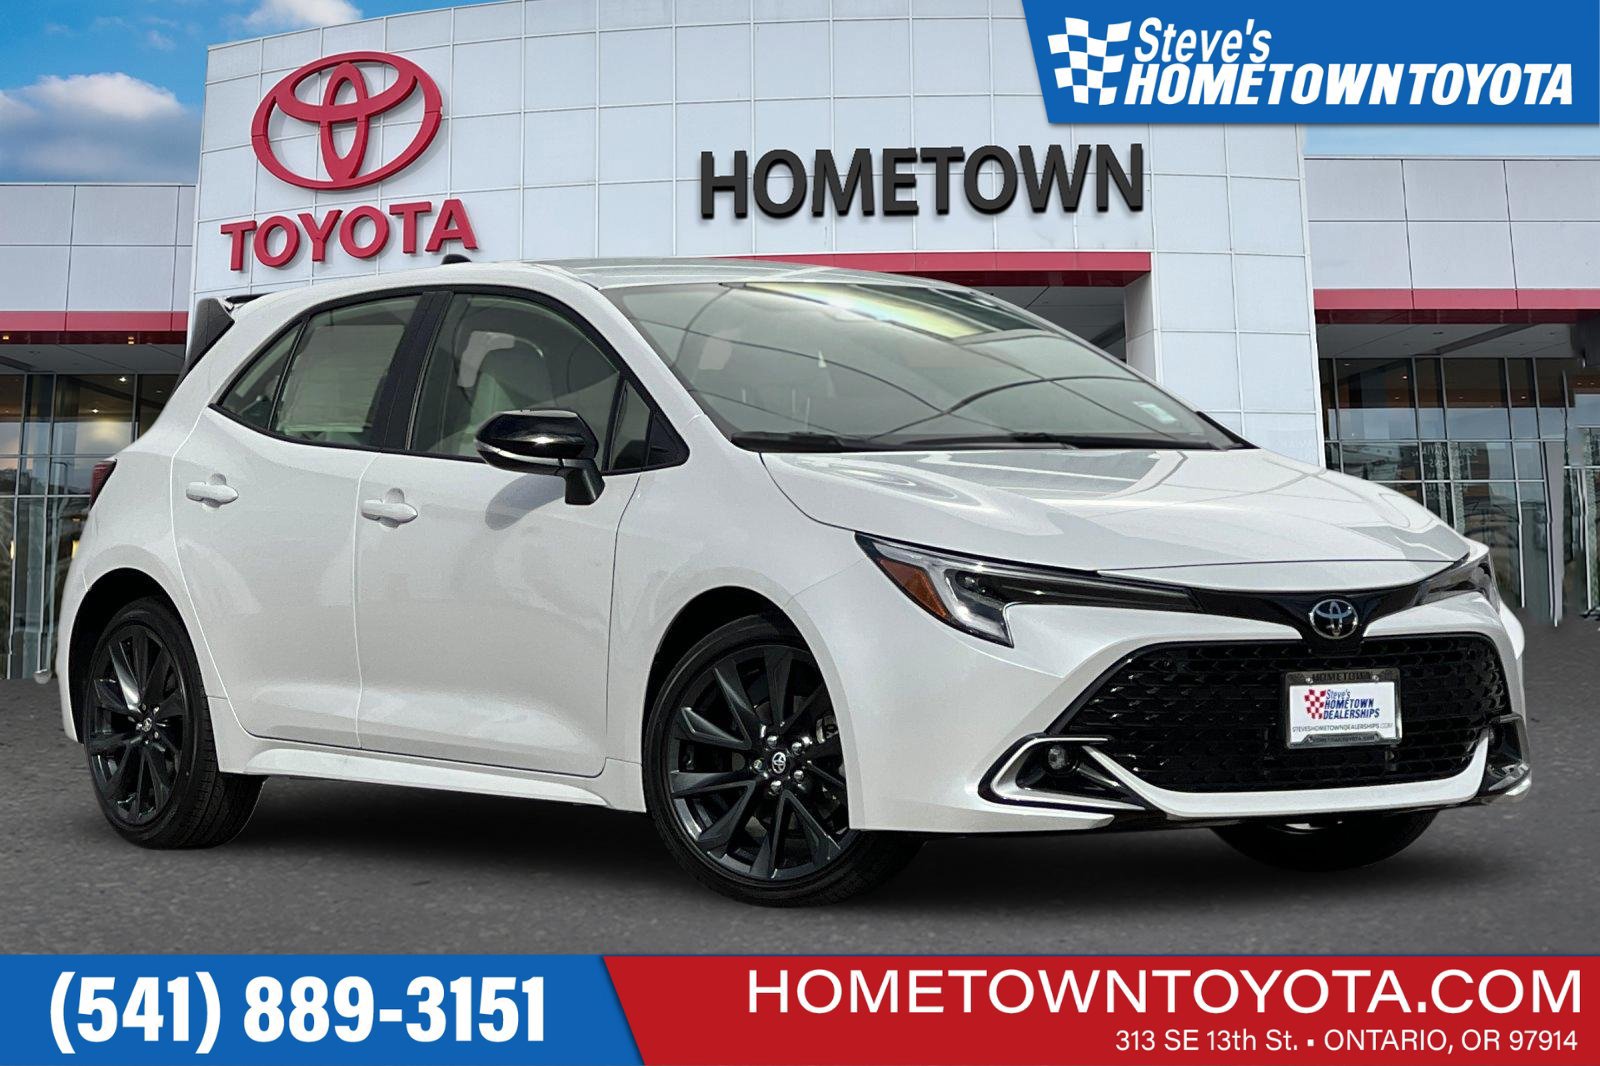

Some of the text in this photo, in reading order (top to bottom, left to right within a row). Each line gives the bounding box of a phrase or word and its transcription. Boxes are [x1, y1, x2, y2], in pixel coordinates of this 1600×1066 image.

[700, 143, 1145, 220] HOMETOWN
[220, 199, 479, 271] TOYOTA
[1326, 689, 1351, 700] Steve's
[1325, 698, 1374, 709] HOMETOWN
[1323, 708, 1380, 720] DEALERSHIPS
